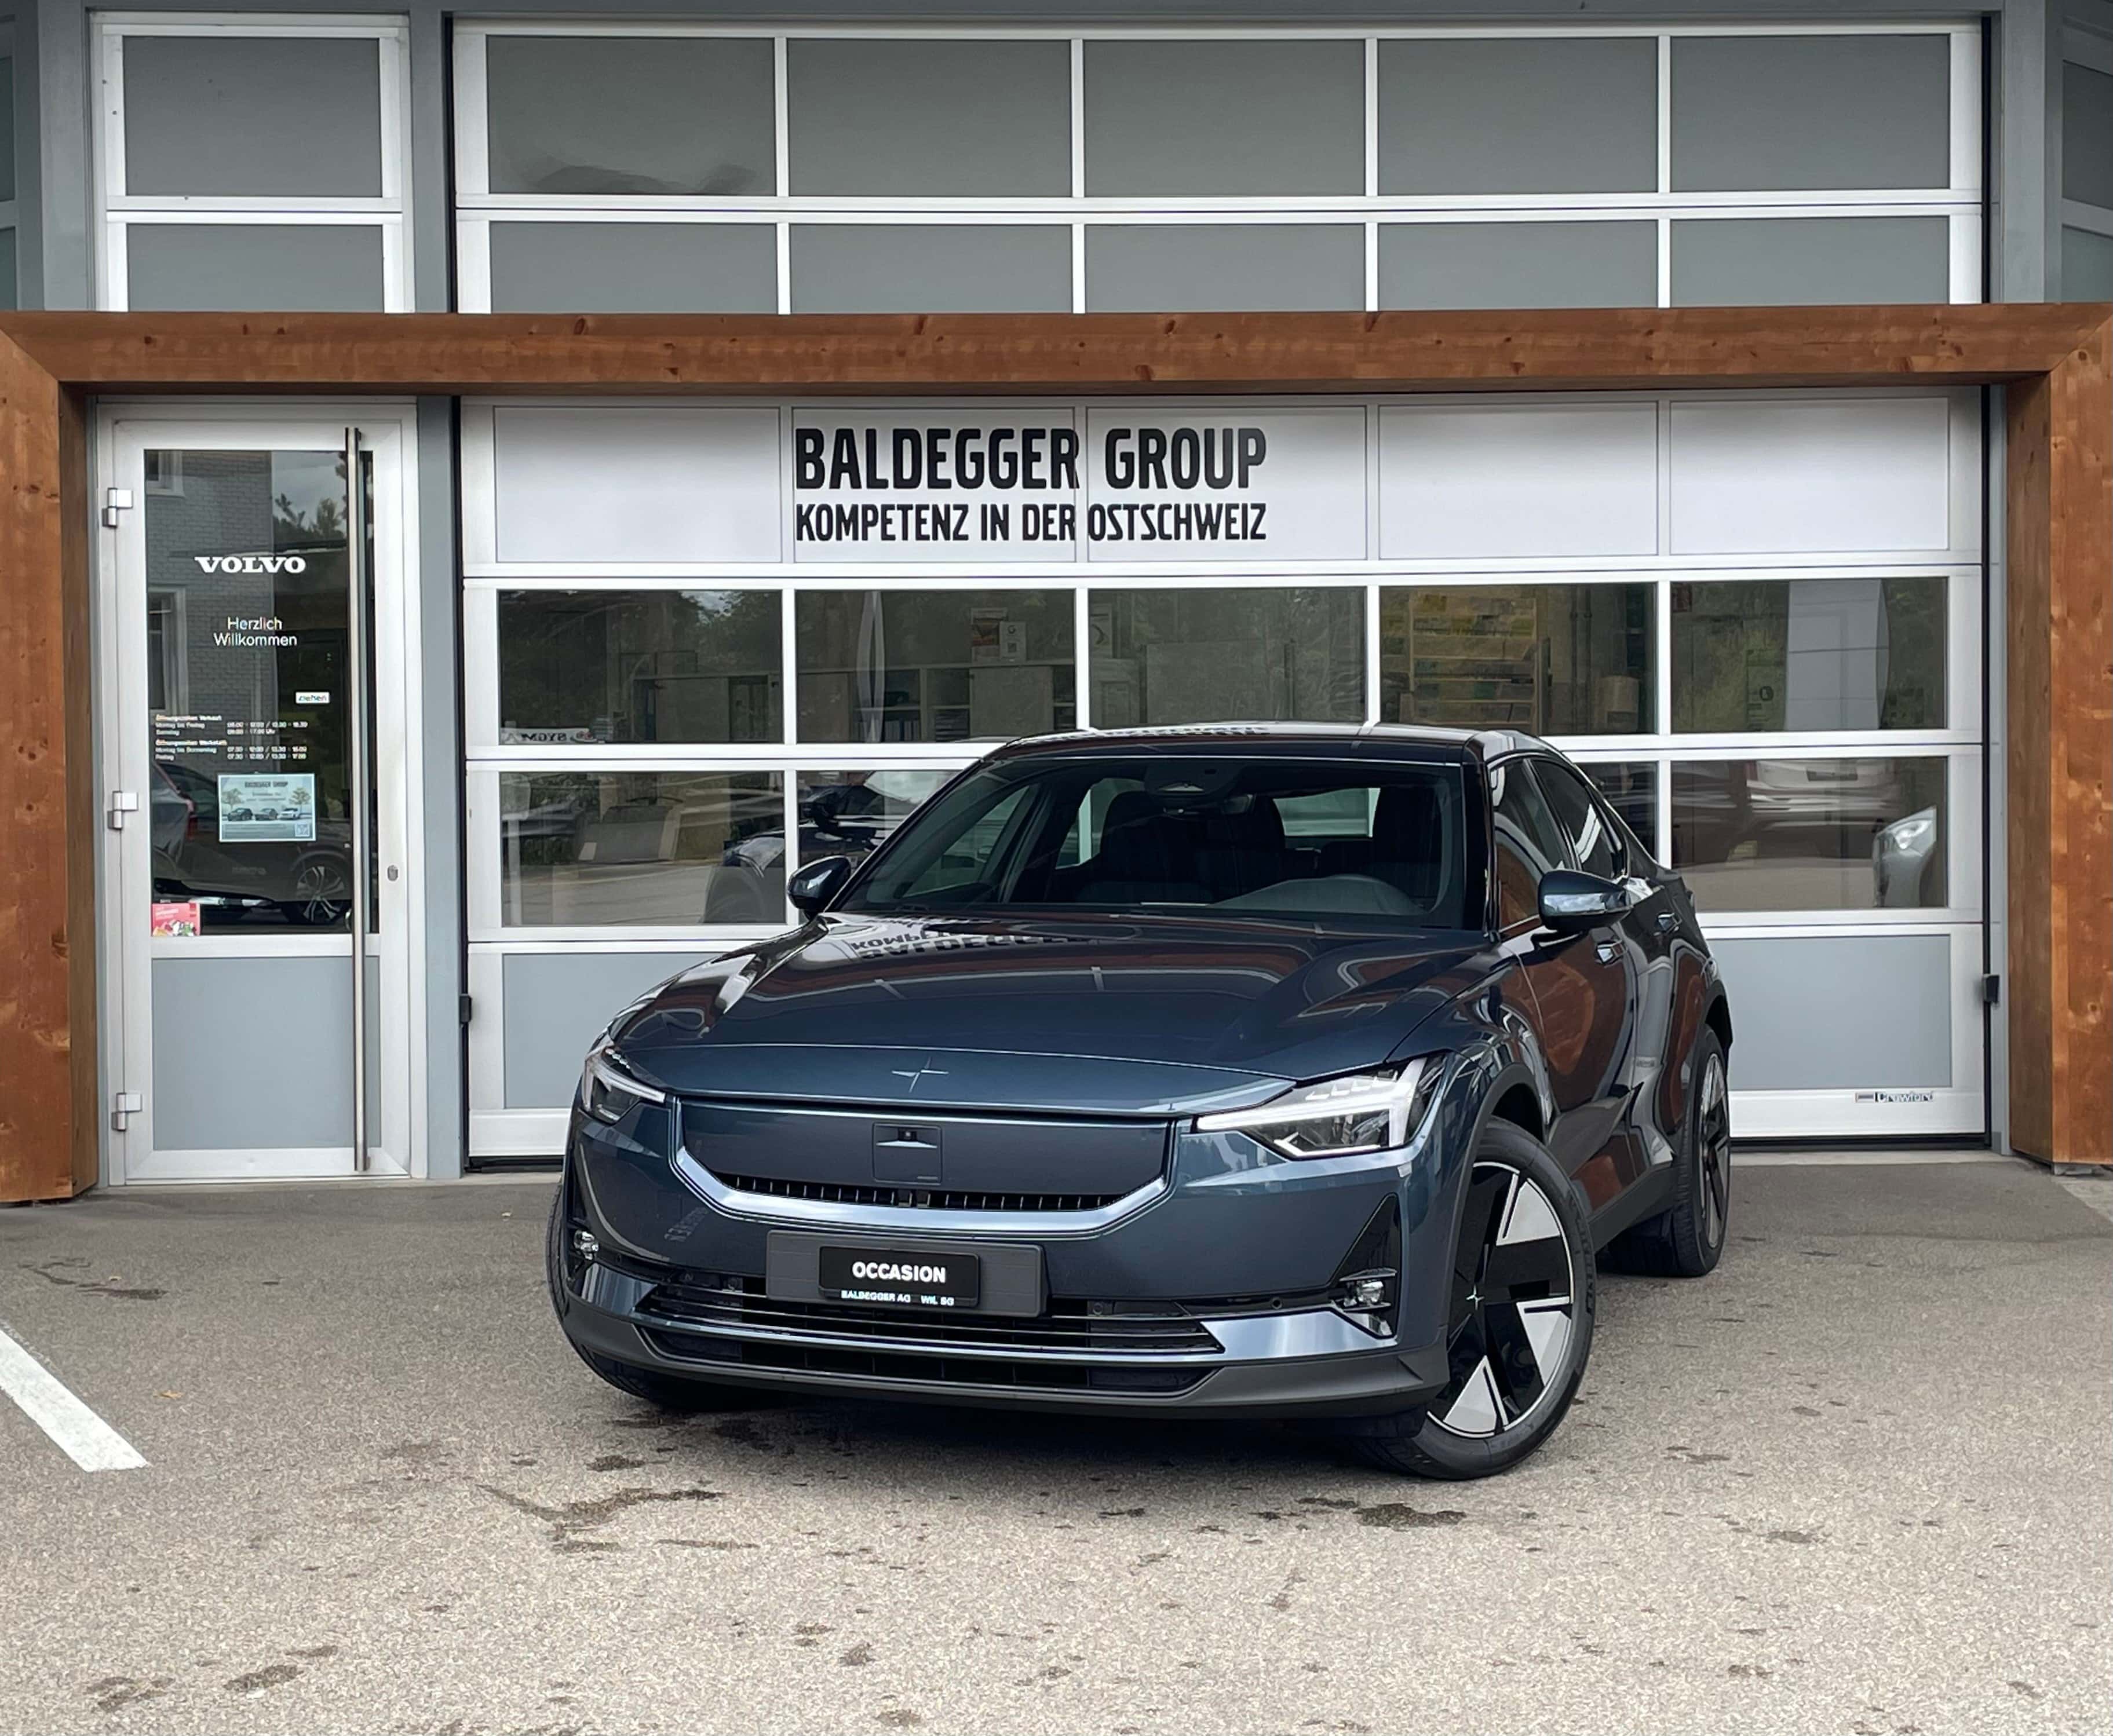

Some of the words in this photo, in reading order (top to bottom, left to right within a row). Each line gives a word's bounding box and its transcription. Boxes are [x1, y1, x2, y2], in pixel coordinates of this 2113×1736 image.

[795, 427, 1079, 489] BALDEGGER
[1105, 427, 1266, 489] GROUP
[796, 504, 969, 541] KOMPETENZ
[981, 504, 1009, 541] IN
[1023, 504, 1075, 541] DER
[1088, 503, 1266, 541] OSTSCHWEIZ
[194, 556, 306, 573] VOLVO
[228, 617, 282, 630] Herzlich
[213, 633, 297, 646] Willkommen
[852, 1262, 946, 1283] OCCASION
[841, 1290, 896, 1303] BALDEGGER
[897, 1293, 911, 1303] AG
[940, 1296, 955, 1306] SG
